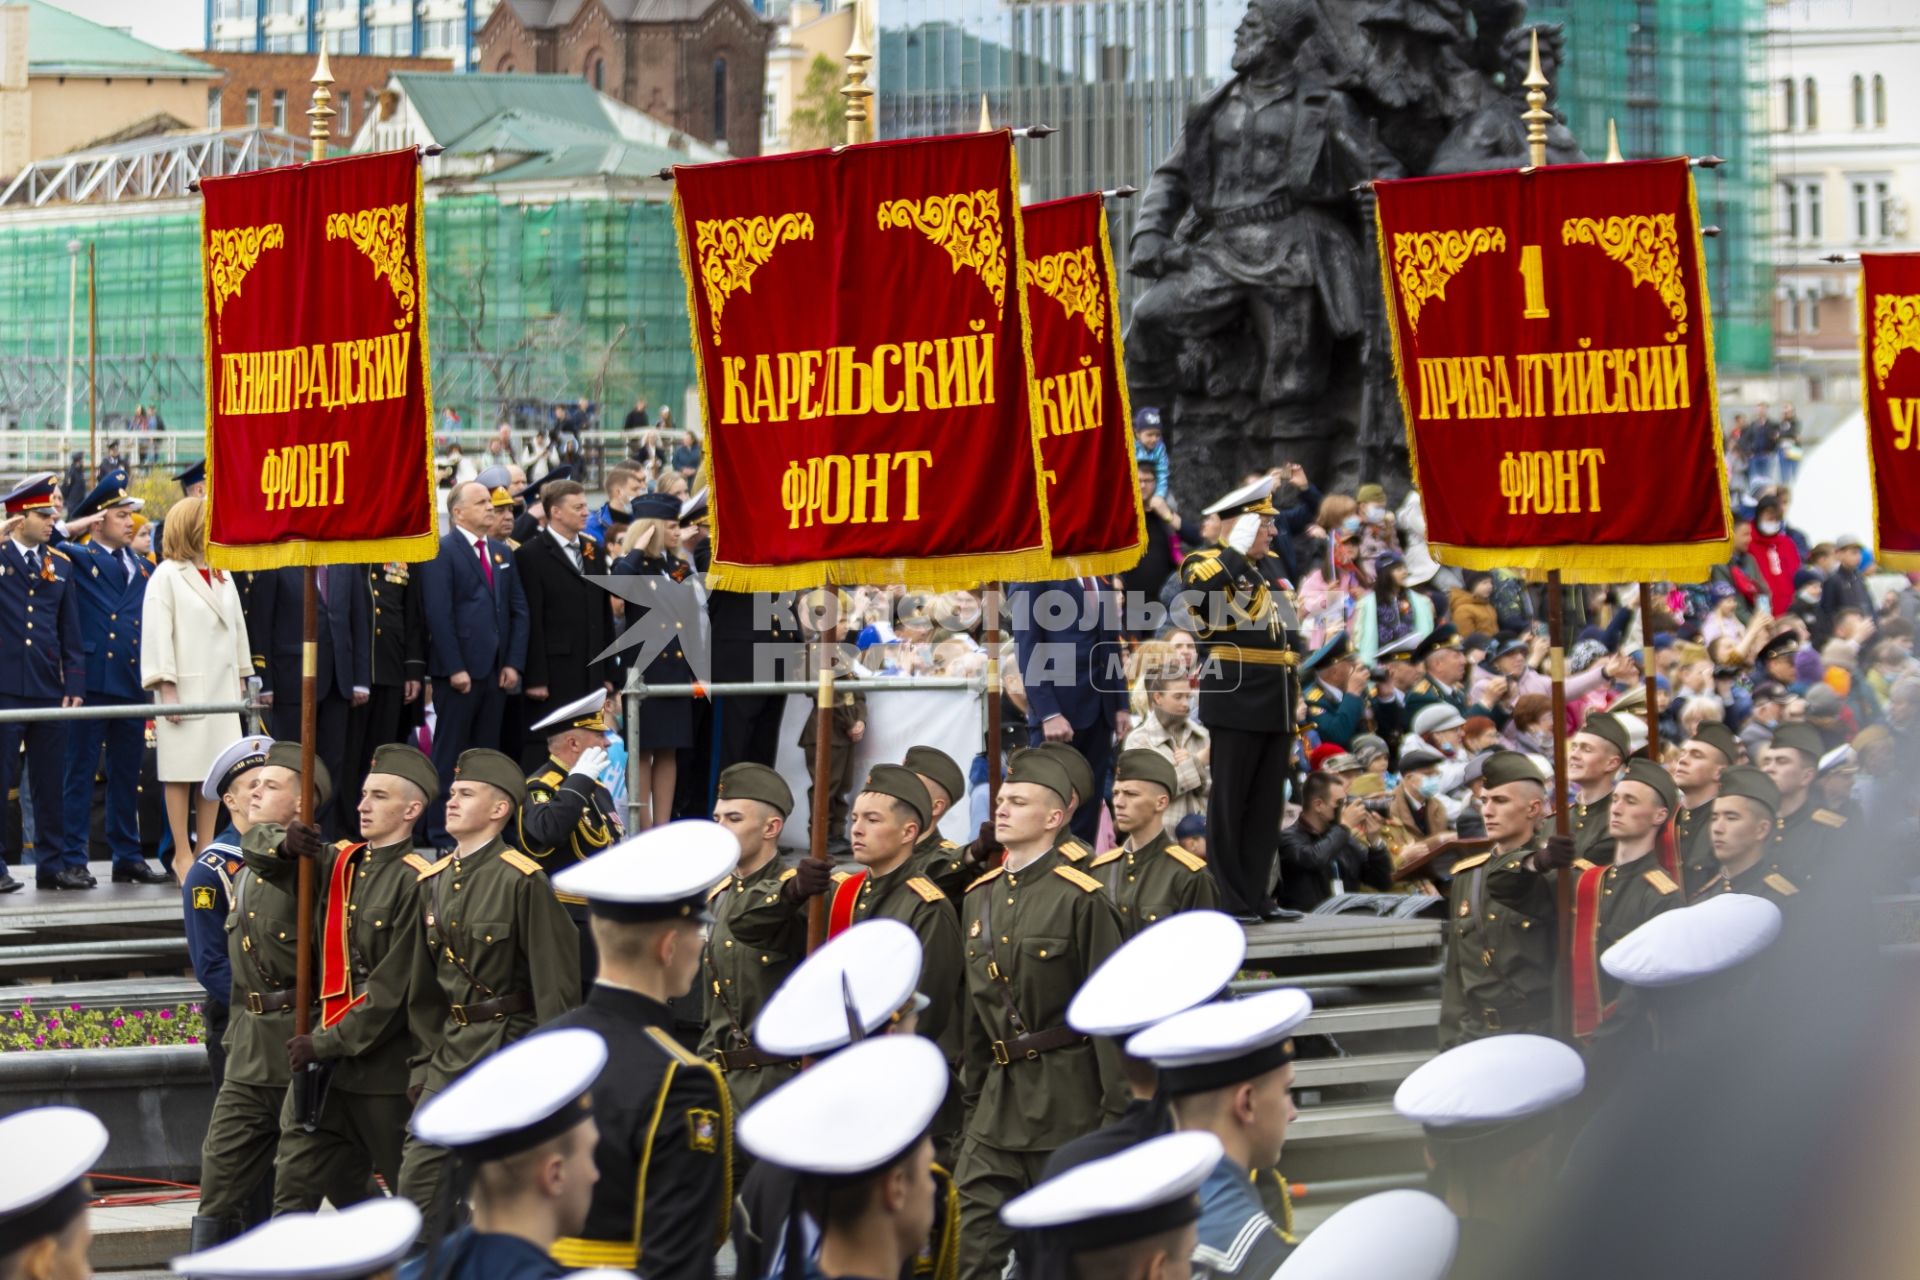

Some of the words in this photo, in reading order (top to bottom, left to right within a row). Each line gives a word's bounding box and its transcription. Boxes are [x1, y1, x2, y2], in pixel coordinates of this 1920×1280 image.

[1519, 245, 1550, 319] 1
[219, 312, 414, 415] ЛЕНИНГРАДСКИЙ
[720, 319, 996, 425] КАРЕЛЬСКИЙ
[1418, 331, 1690, 420] ПРИБАЛТИЙСКИЙ
[1886, 397, 1920, 451] У
[261, 440, 350, 511] ФРОНТ
[781, 450, 933, 529] ФРОНТ
[1500, 448, 1605, 515] ФРОНТ
